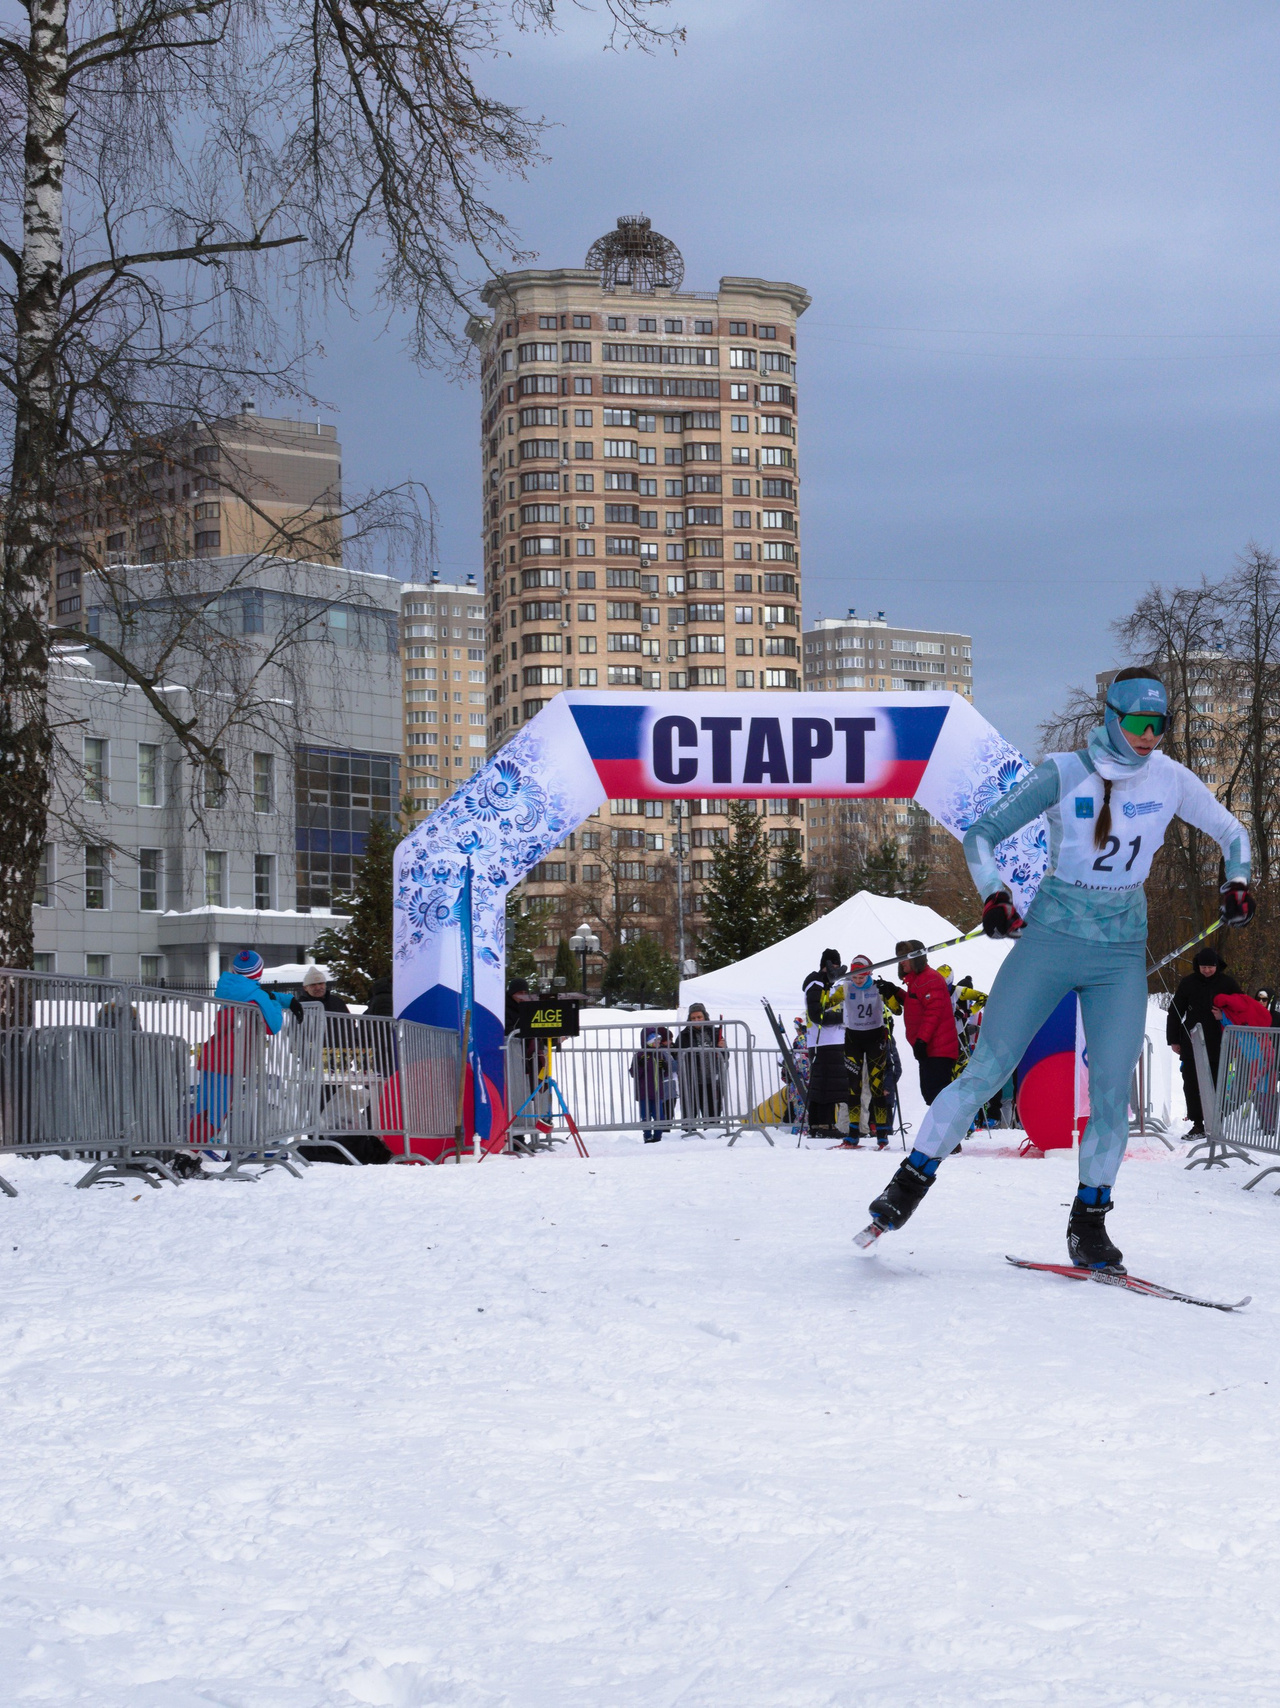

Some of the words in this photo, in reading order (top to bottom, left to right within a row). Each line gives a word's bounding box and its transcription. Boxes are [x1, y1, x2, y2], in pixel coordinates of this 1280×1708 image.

[652, 715, 875, 784] СТАРТ
[1092, 835, 1142, 872] 21
[531, 1009, 562, 1022] ALGE
[857, 1003, 873, 1018] 24
[905, 1164, 928, 1182] SPINE
